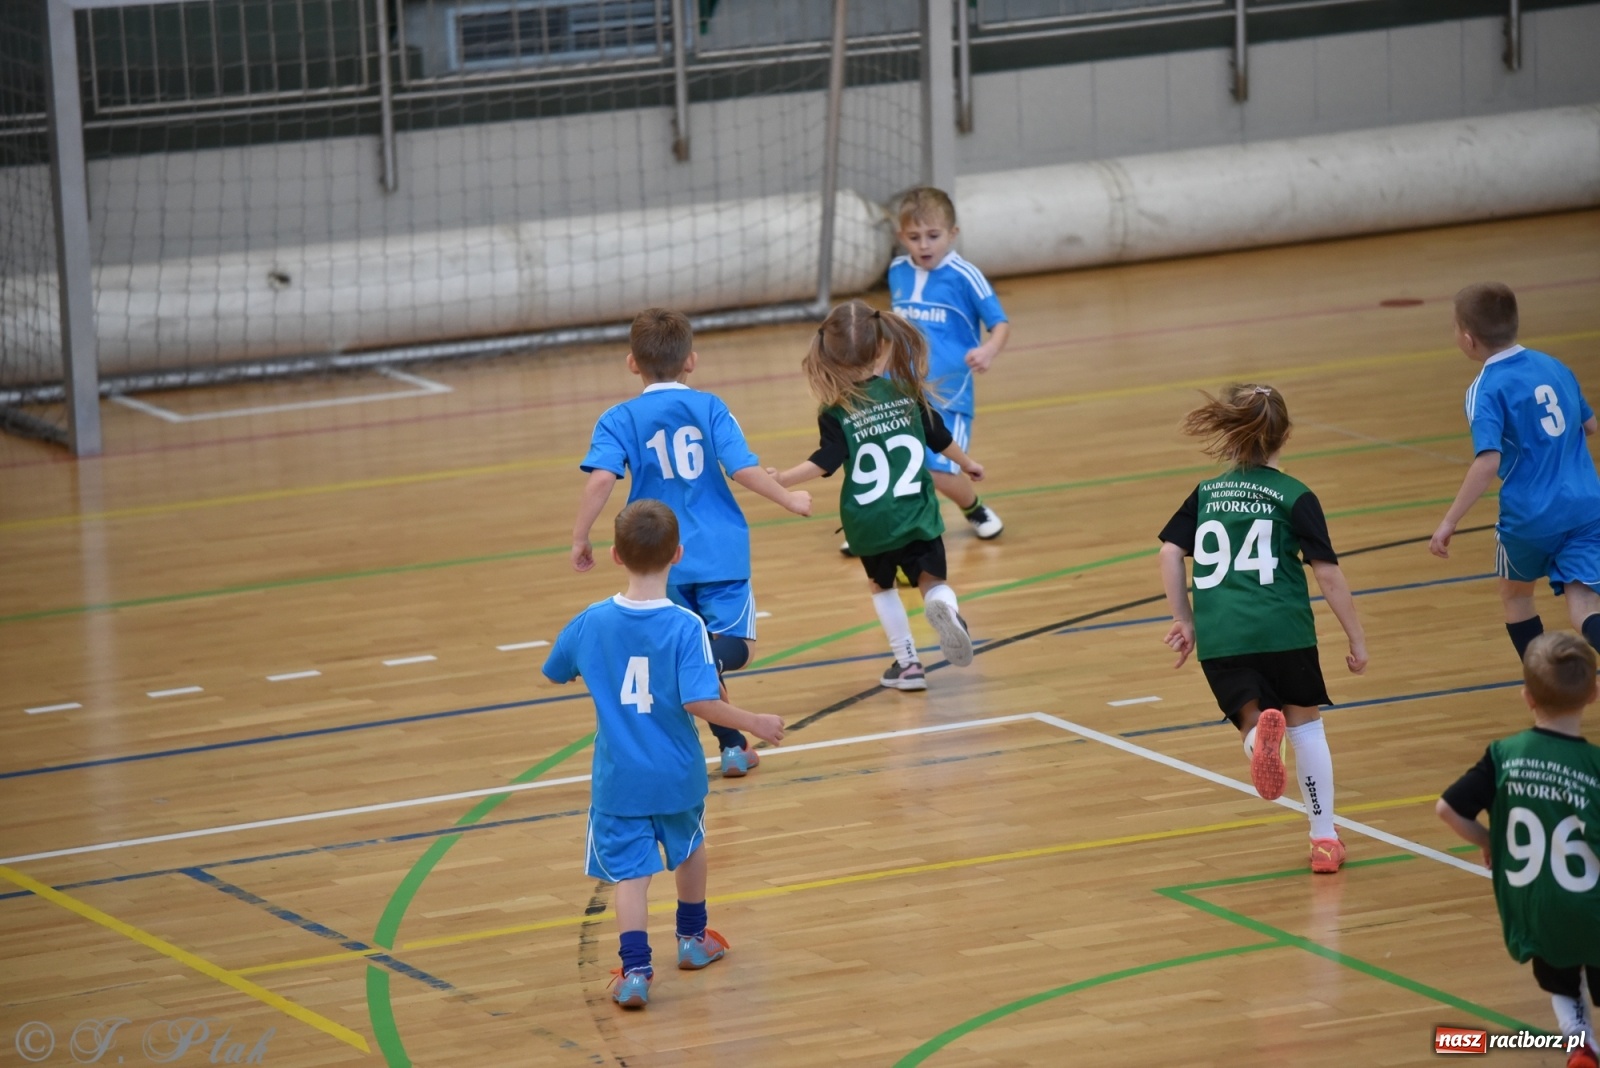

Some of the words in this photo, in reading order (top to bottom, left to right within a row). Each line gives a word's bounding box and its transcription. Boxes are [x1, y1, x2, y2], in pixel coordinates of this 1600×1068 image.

[1534, 384, 1566, 437] 3
[645, 425, 704, 480] 16
[851, 433, 925, 506] 92
[1201, 481, 1239, 492] AKADEMIA
[1205, 500, 1276, 515] TWORKÓW
[1193, 518, 1279, 590] 94
[620, 656, 654, 714] 4
[1505, 806, 1600, 893] 96
